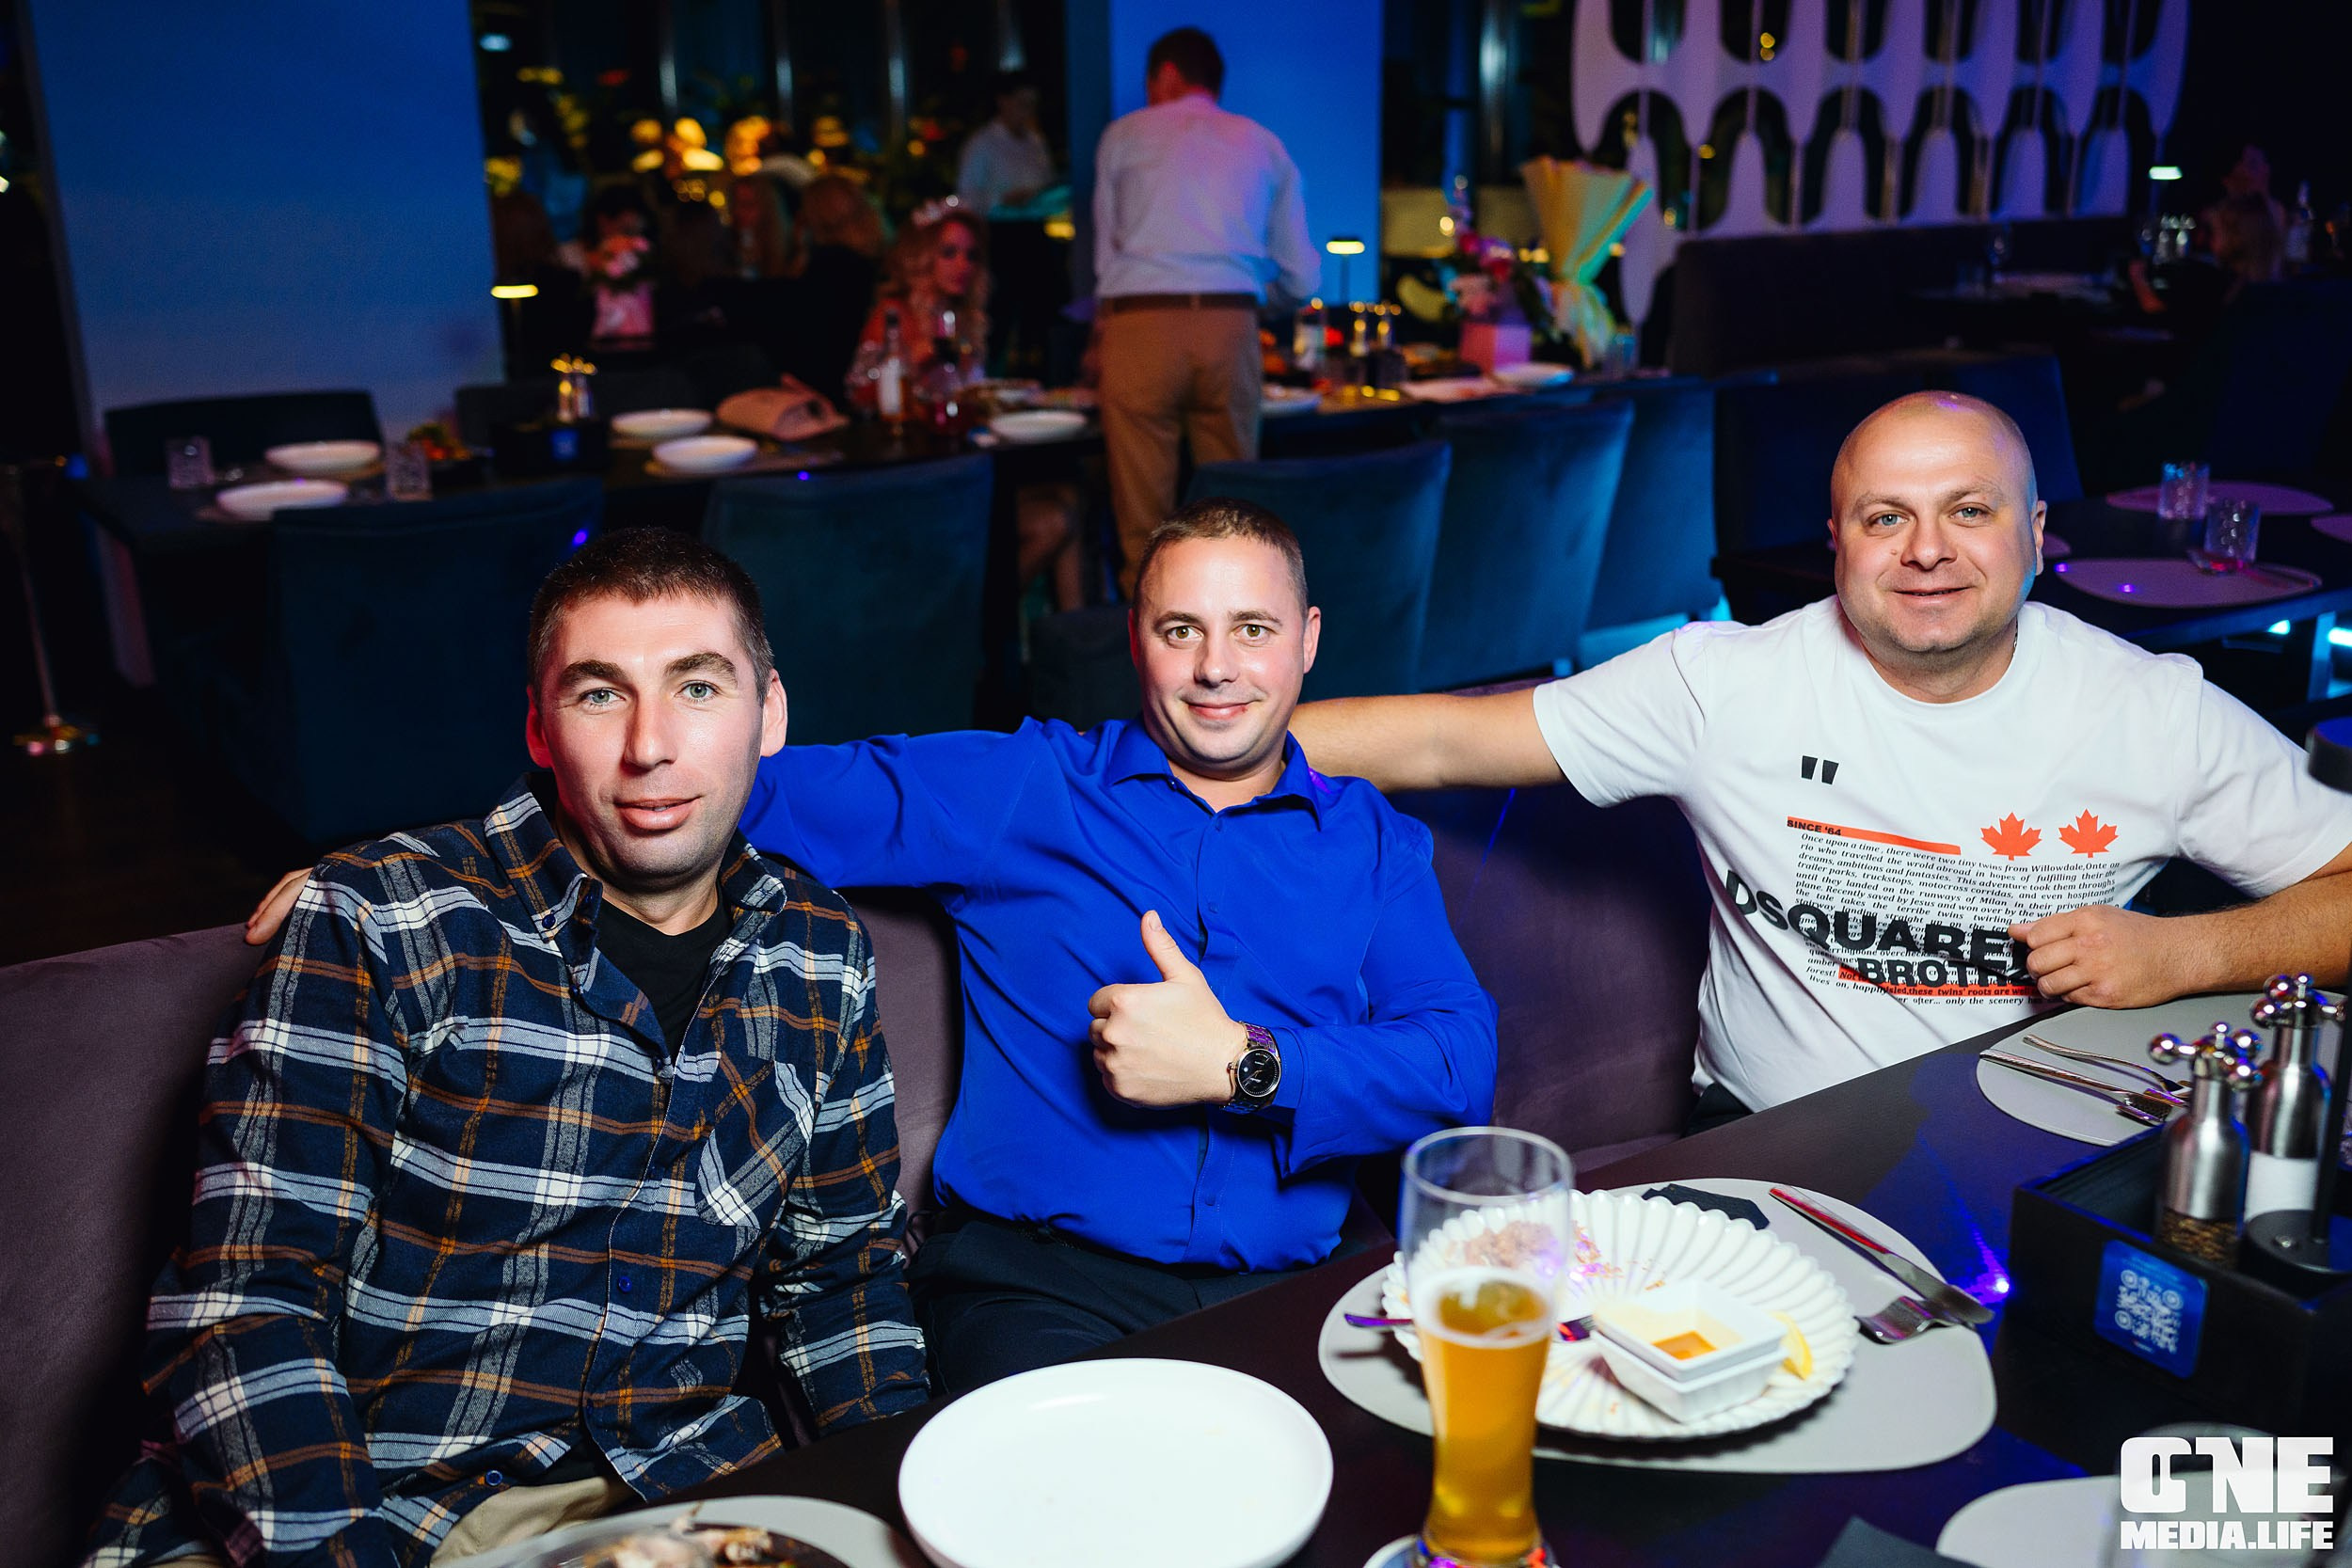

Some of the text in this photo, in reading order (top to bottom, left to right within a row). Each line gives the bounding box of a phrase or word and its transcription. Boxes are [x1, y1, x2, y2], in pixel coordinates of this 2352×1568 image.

[1787, 820, 1822, 832] SINCE
[1818, 847, 1837, 855] who
[1841, 850, 1883, 863] travelled
[1887, 857, 1902, 865] the
[1907, 861, 1934, 870] wrold
[1936, 865, 1971, 876] abroad
[1990, 871, 2015, 881] hopes
[2020, 874, 2031, 883] of
[2037, 873, 2077, 883] fulfilling
[1826, 839, 1848, 847] upon
[1886, 847, 1911, 857] there
[1913, 853, 1936, 861] were
[1958, 859, 1976, 869] tiny
[1979, 863, 2002, 871] twins
[1797, 861, 1828, 872] trailer
[1828, 867, 1858, 878] parks,
[1862, 872, 1914, 886] truckstops,
[1919, 881, 1969, 892] motocross
[1971, 887, 2014, 899] corridas,
[1798, 852, 1835, 866] dreams,
[1836, 860, 1883, 872] ambitions
[1957, 876, 1977, 885] This
[1979, 880, 2027, 890] adventure
[1796, 872, 1818, 881] until
[1822, 876, 1842, 886] they
[1846, 879, 1878, 890] landed
[1920, 891, 1961, 902] runways
[1980, 897, 2007, 906] Milan
[1826, 886, 1865, 898] Recently
[1867, 893, 1895, 902] saved
[1897, 896, 1908, 905] by
[1910, 898, 1935, 907] Jesus
[2005, 908, 2016, 917] by
[1816, 893, 1834, 902] tale
[1841, 897, 1866, 907] takes
[1897, 905, 1931, 915] terribe
[1938, 910, 1964, 919] twins
[1973, 914, 2012, 926] twirling
[1806, 966, 1836, 977] forest!
[1808, 958, 1837, 967] amber
[1810, 975, 1830, 985] lives
[1946, 998, 1966, 1006] only
[1988, 998, 2024, 1006] scenery
